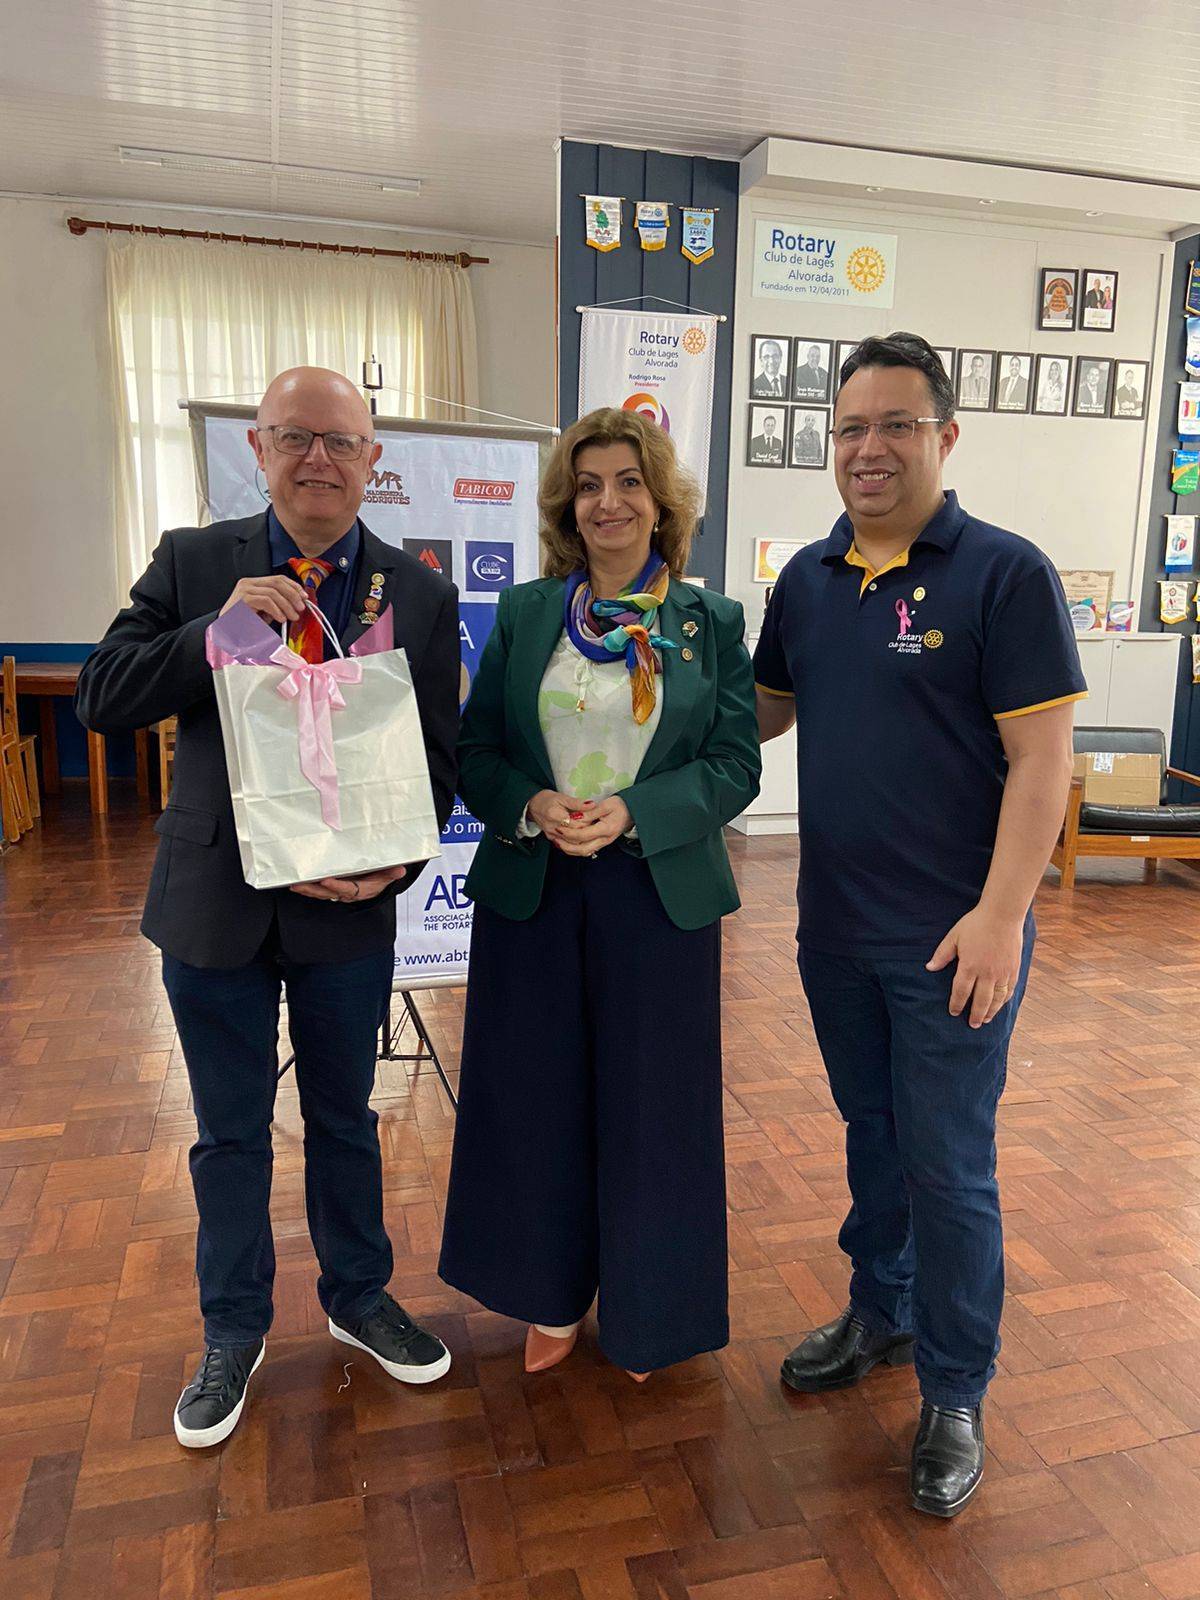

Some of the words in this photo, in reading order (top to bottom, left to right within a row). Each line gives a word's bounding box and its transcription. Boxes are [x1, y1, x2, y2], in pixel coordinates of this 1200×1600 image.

[772, 229, 836, 258] Rotary
[764, 251, 787, 263] Club
[790, 253, 803, 265] de
[806, 255, 835, 270] Lages
[788, 270, 834, 283] Alvorada
[761, 282, 794, 292] Fundado
[809, 286, 850, 296] 12/04/2011
[640, 331, 680, 348] Rotary
[628, 347, 646, 356] Club
[647, 348, 657, 357] de
[658, 349, 679, 360] Lages
[644, 359, 678, 368] Alvorada
[459, 483, 511, 496] TABICON
[896, 633, 924, 643] Rotary
[454, 823, 464, 834] o
[424, 923, 438, 931] THE
[404, 949, 469, 965] www.abt
